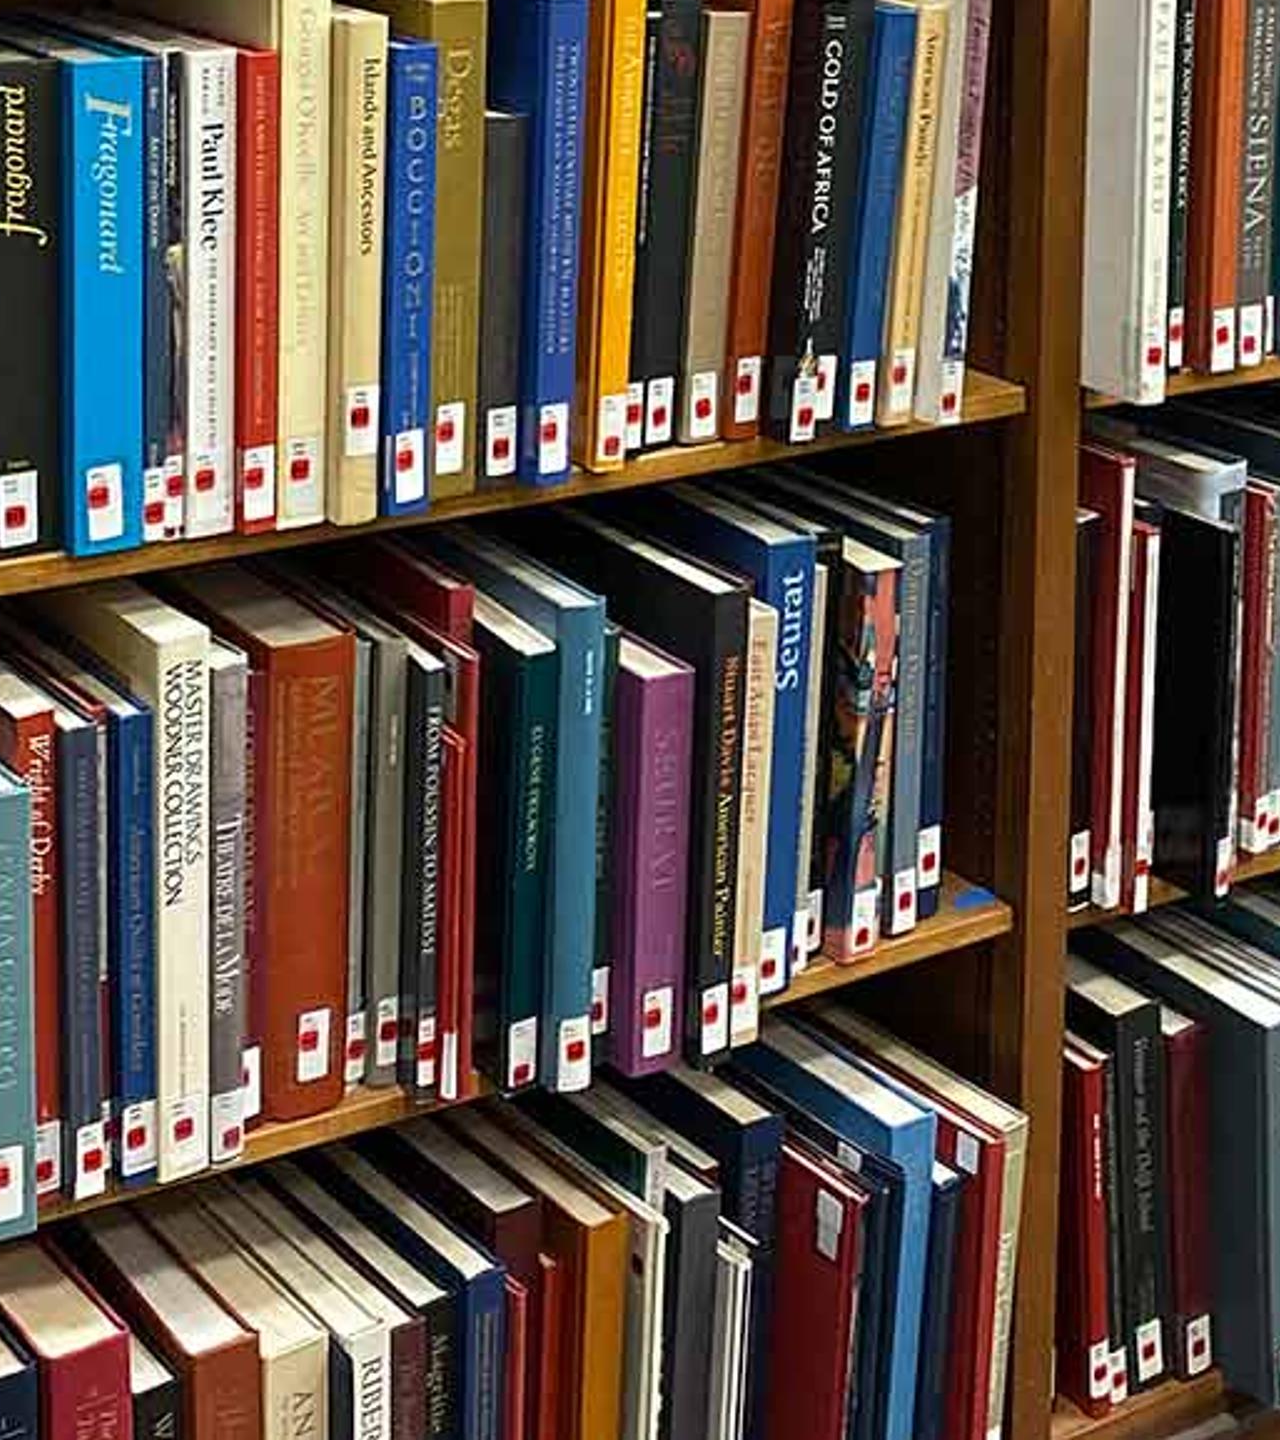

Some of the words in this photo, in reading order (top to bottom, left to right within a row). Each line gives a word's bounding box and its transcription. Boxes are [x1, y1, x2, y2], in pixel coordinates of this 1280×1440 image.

[362, 57, 381, 122] Islands
[441, 48, 474, 149] Degas
[821, 37, 844, 110] GOLD
[200, 121, 228, 182] Paul
[361, 128, 381, 158] and
[817, 114, 839, 146] OF
[85, 92, 137, 275] Fragonard
[360, 164, 380, 254] Ancestors
[810, 150, 834, 234] AFRICA
[1243, 114, 1269, 233] SIENA
[199, 189, 226, 250] Klee
[404, 95, 428, 337] BOCCIONI
[751, 640, 768, 682] East
[775, 569, 806, 691] Seurat
[165, 663, 184, 774] WOODNER
[185, 658, 204, 742] MASTER
[722, 654, 740, 727] Stuart
[748, 690, 766, 737] Asian
[29, 733, 51, 802] Wright
[720, 732, 737, 787] Davis
[31, 809, 51, 829] of
[184, 749, 203, 863] DRAWINGS
[423, 763, 441, 846] POUSSIN
[716, 794, 735, 882] American
[165, 779, 184, 905] COLLECTION
[423, 852, 439, 876] TO
[421, 882, 439, 954] MATISSE
[714, 889, 732, 956] Painter
